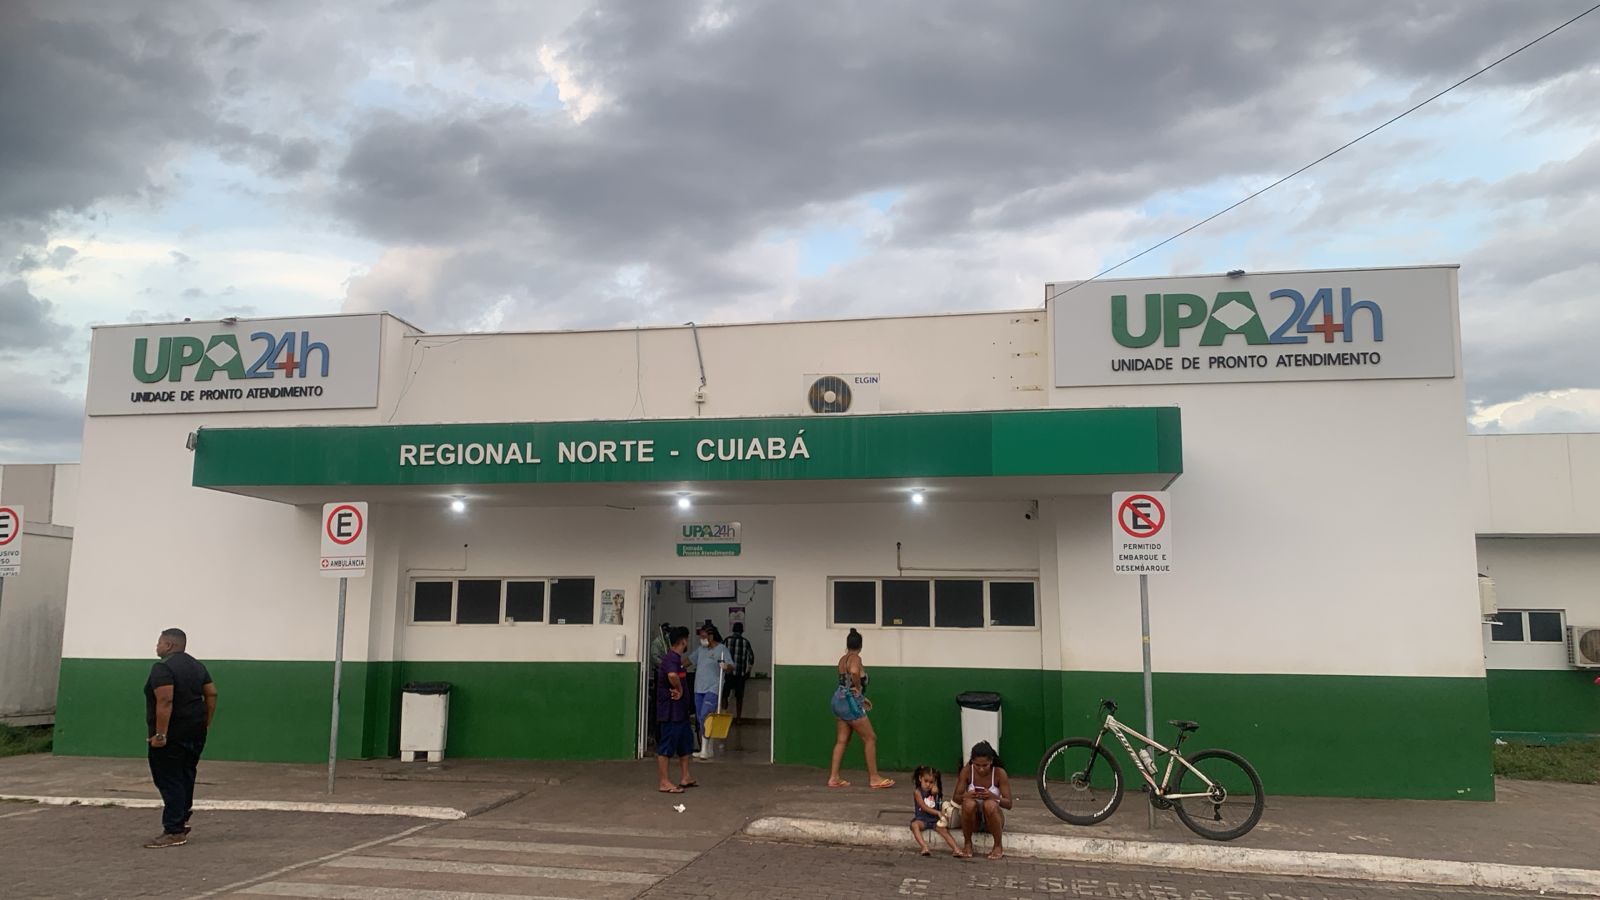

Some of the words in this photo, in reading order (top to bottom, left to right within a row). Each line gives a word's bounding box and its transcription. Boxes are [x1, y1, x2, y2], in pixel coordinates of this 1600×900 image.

[1112, 357, 1173, 371] UNIDADE
[1181, 357, 1200, 369] DE
[1208, 354, 1268, 369] PRONTO
[1276, 351, 1381, 367] ATENDIMENTO
[131, 391, 176, 403] UNIDADE
[180, 390, 195, 401] DE
[199, 388, 243, 400] PRONTO
[246, 385, 323, 399] ATENDIMENTO
[400, 442, 541, 466] REGIONAL
[558, 440, 654, 463] NORTE
[696, 429, 810, 462] CUIABÁ
[337, 513, 353, 537] E
[330, 559, 365, 567] AMBULÂNCIA
[1116, 564, 1170, 572] DESEMBARQUE
